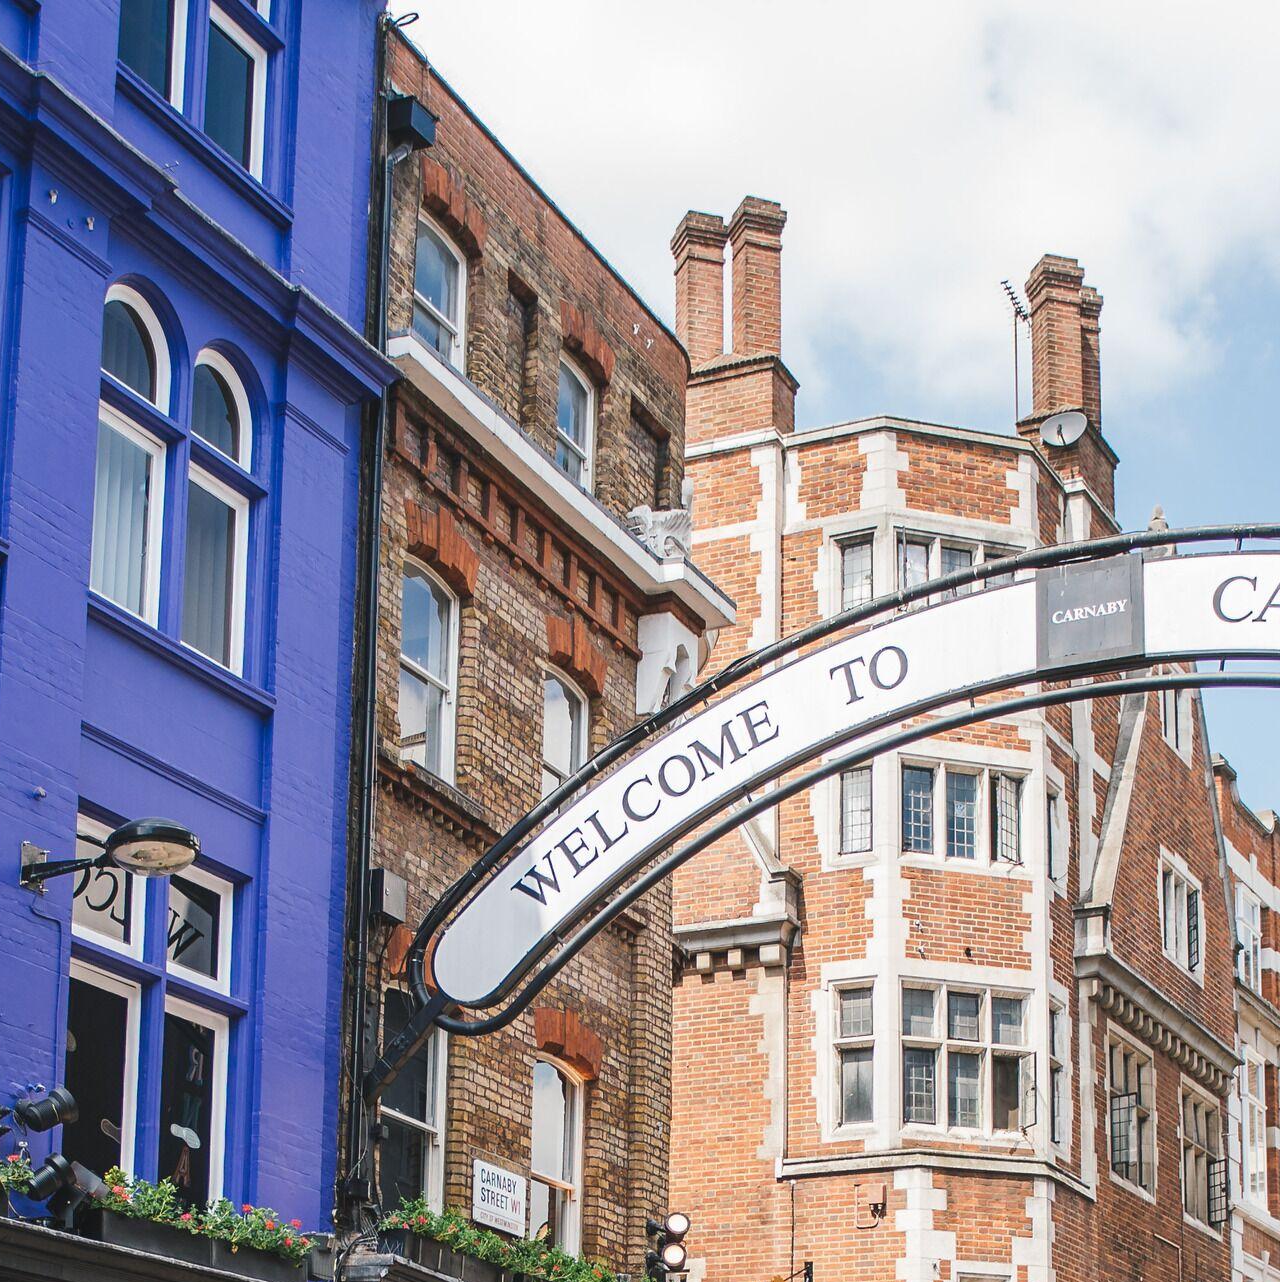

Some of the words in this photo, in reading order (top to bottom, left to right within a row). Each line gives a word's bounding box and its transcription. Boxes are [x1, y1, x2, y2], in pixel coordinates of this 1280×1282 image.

[1052, 599, 1127, 624] CARNABY
[511, 701, 779, 906] WELCOME
[830, 645, 908, 705] TO
[480, 1168, 517, 1194] CARNABY
[480, 1187, 508, 1210] STREET
[511, 1198, 520, 1214] W1
